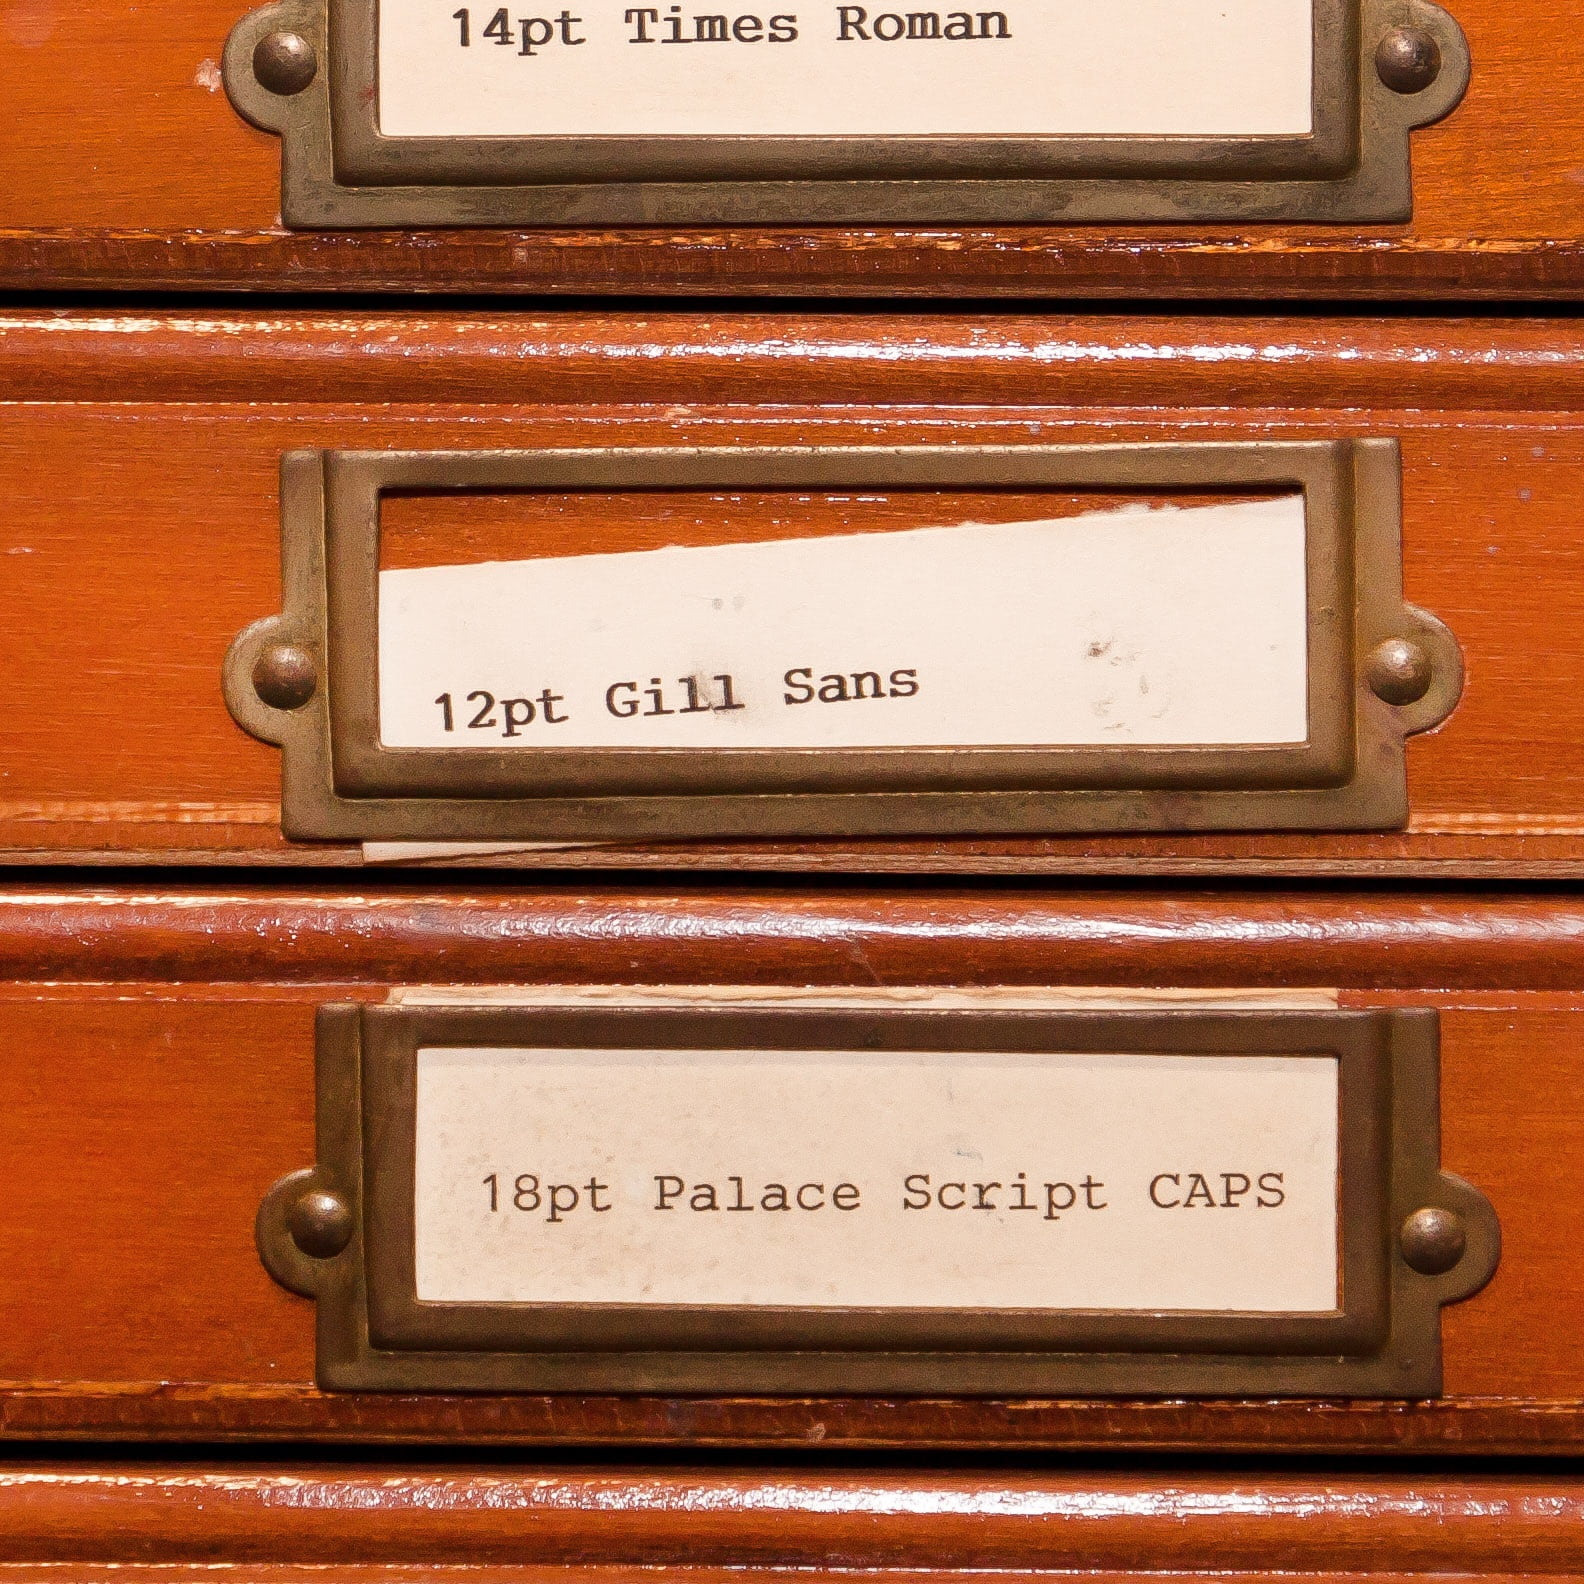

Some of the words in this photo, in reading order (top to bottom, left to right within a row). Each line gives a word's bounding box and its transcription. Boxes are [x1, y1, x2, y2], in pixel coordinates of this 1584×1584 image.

[452, 7, 587, 57] 14pt
[624, 5, 799, 44] Times
[835, 5, 1013, 42] Roman
[434, 688, 570, 739] 12pt
[605, 674, 746, 719] Gill
[783, 667, 920, 706] Sans
[482, 1172, 613, 1223] 18pt
[653, 1175, 861, 1212] Palace
[903, 1172, 1108, 1221] Script
[1149, 1172, 1286, 1209] CAPS
